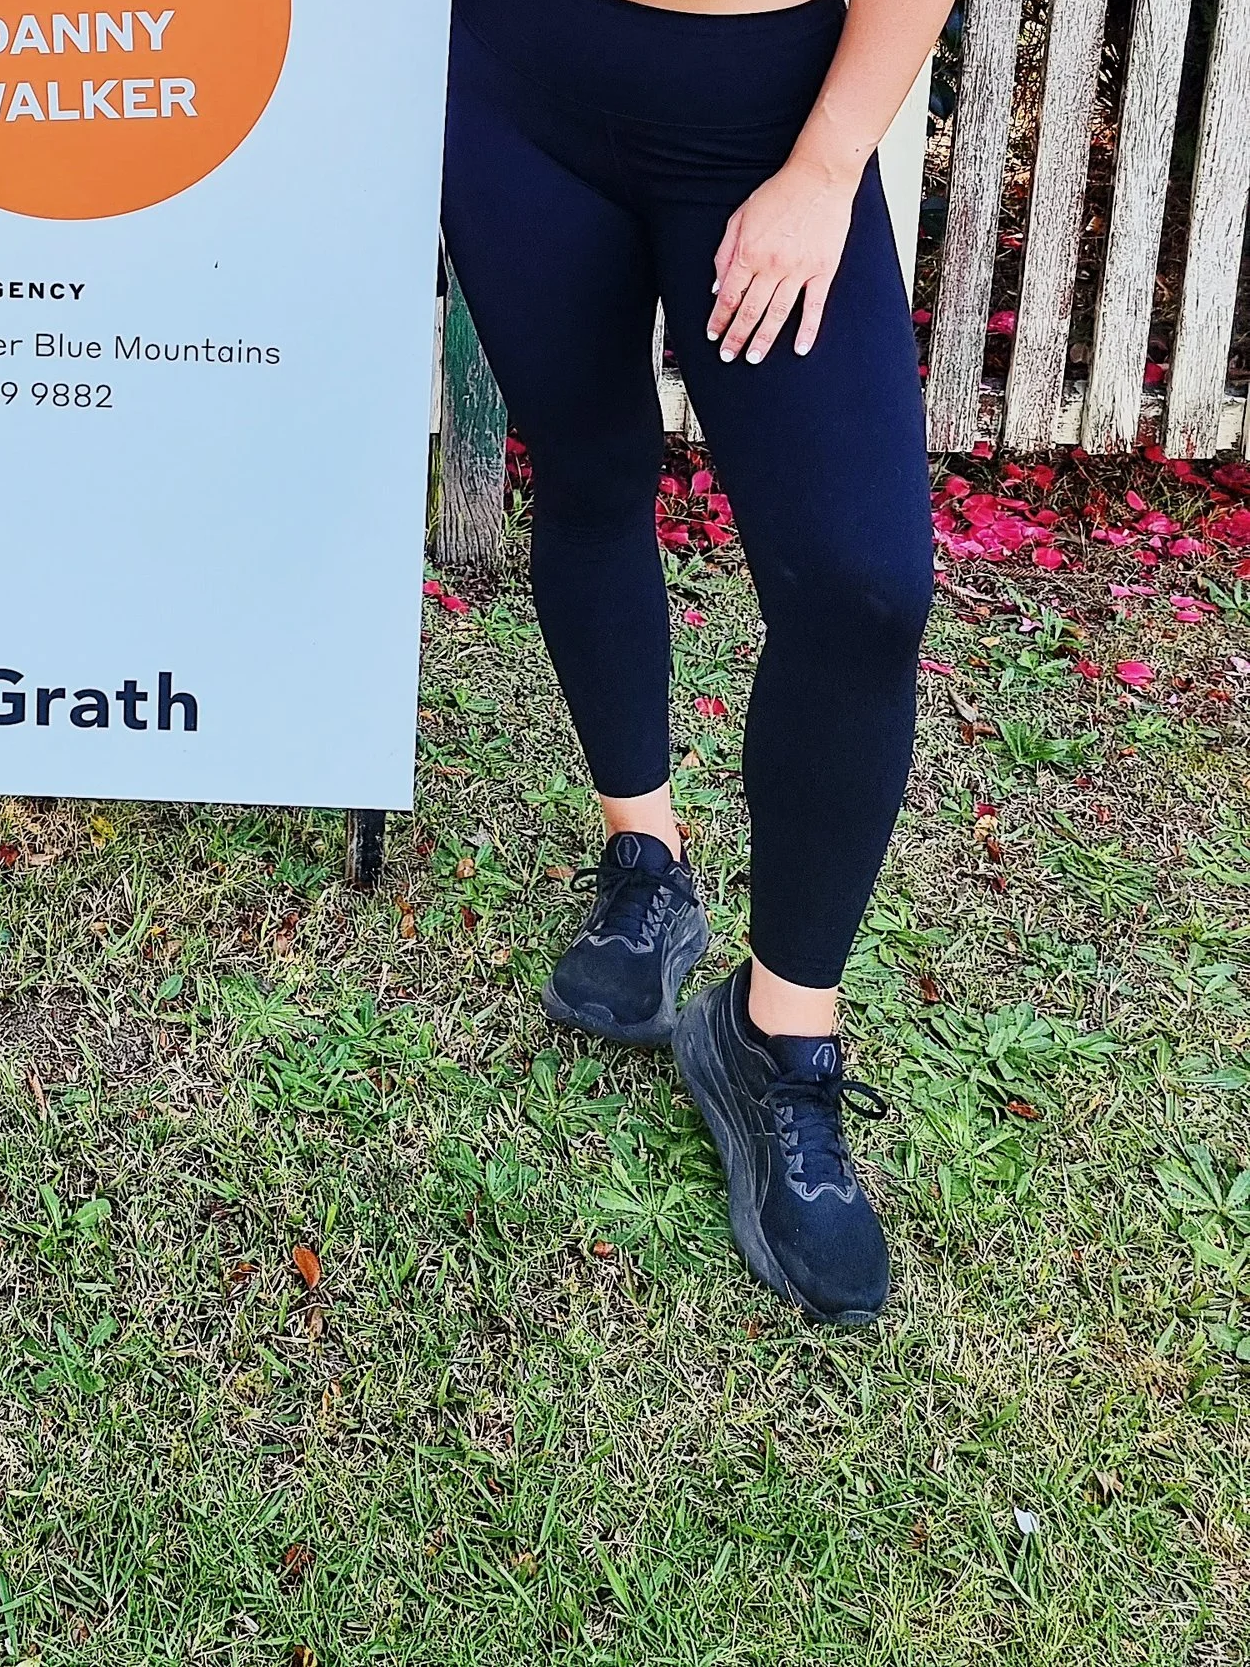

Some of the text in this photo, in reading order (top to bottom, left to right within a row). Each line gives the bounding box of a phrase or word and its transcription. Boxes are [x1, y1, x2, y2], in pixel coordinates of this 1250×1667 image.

[34, 332, 103, 360] Blue
[114, 335, 282, 366] Mountains
[30, 382, 114, 410] 9882
